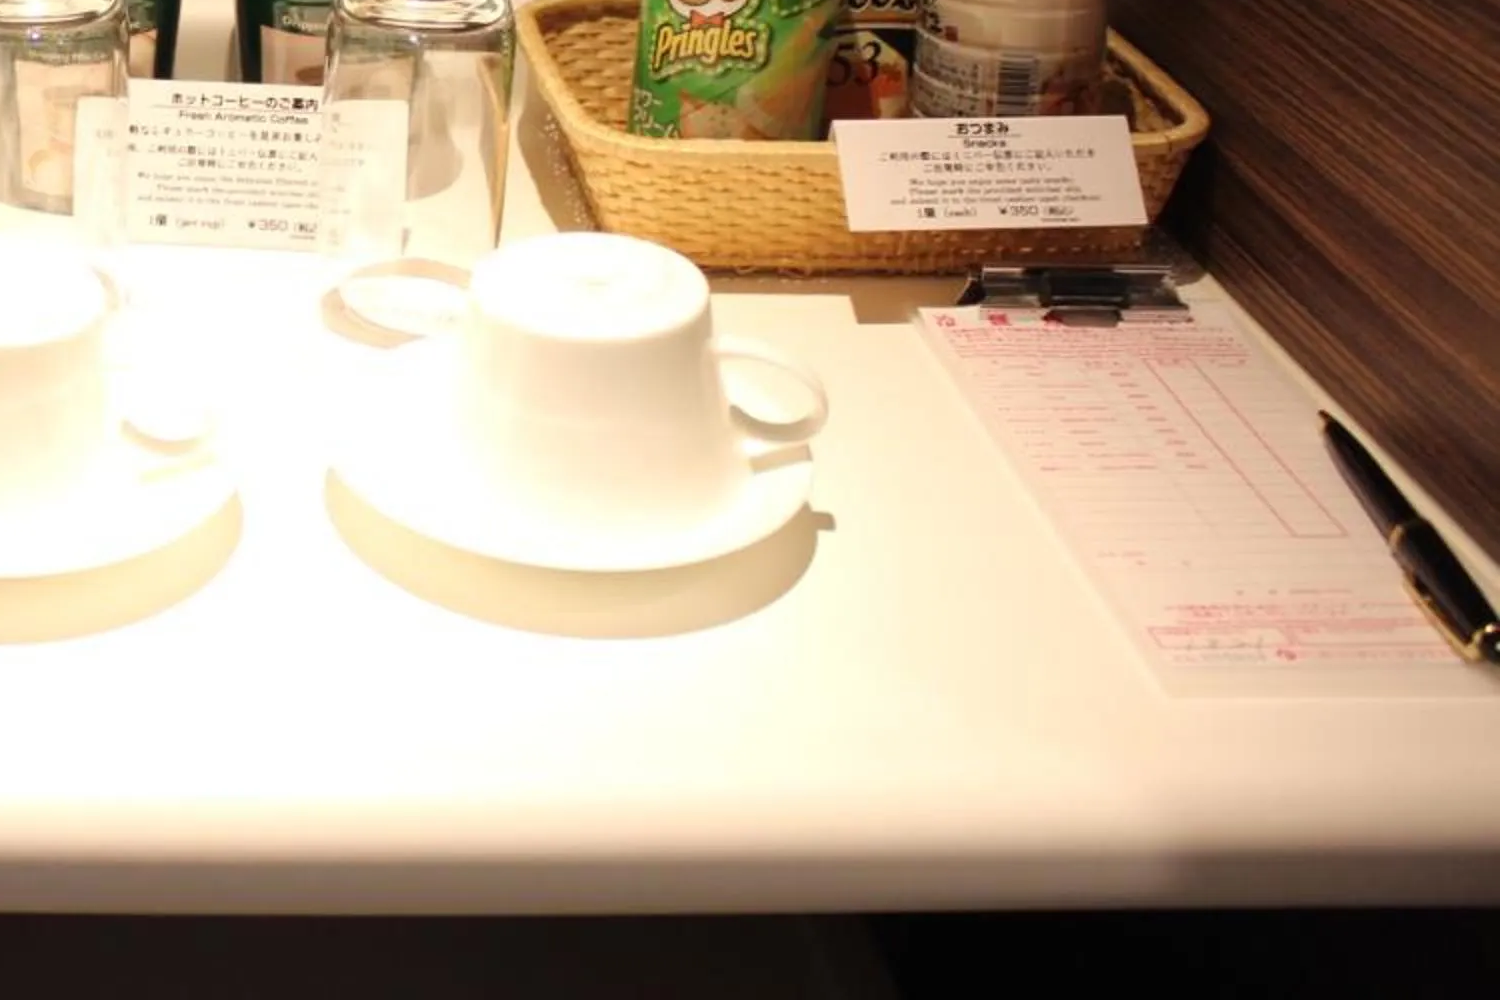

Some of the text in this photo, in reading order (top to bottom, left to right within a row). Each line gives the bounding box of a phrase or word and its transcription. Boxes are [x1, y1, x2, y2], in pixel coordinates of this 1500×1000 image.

[652, 21, 758, 72] Pringles
[172, 93, 319, 111] ホットコーヒーのご案内
[956, 122, 1009, 135] おつまみ
